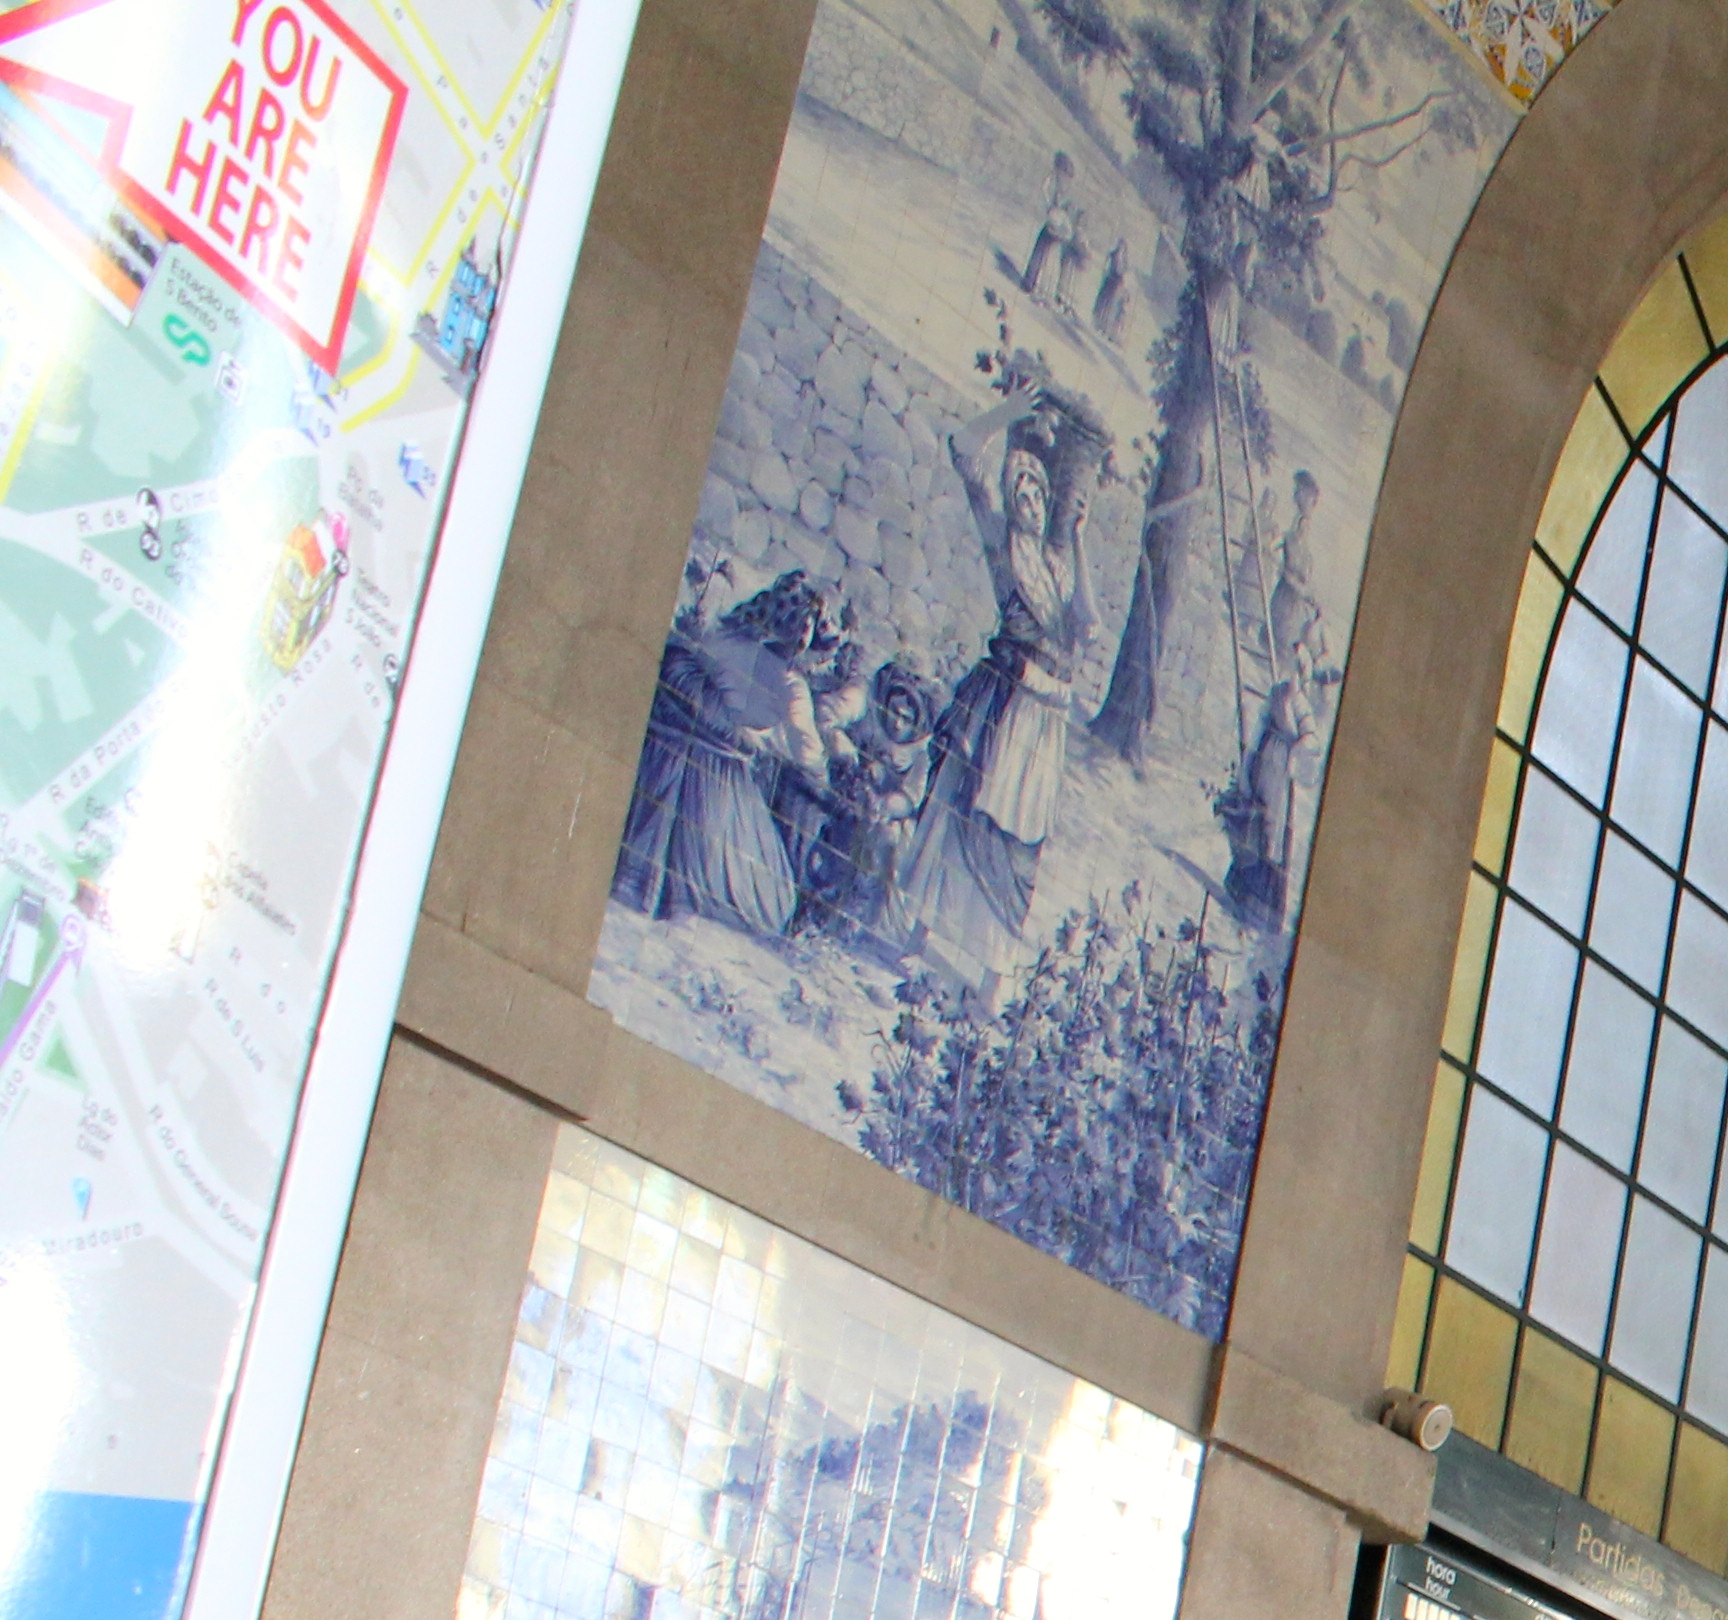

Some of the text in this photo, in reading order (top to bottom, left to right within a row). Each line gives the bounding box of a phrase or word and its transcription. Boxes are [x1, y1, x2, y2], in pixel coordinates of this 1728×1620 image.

[231, 0, 342, 122] YOU
[202, 58, 318, 206] ARE
[165, 117, 311, 302] HERE
[171, 257, 223, 311] Estação
[177, 288, 218, 332] Bento
[77, 512, 92, 533] R
[103, 509, 126, 528] de
[79, 548, 93, 571] R
[102, 566, 123, 592] do
[49, 783, 64, 804] R
[70, 764, 90, 789] da
[94, 720, 141, 767] Porta
[20, 1000, 57, 1061] Gama
[1424, 1575, 1453, 1601] hour
[1425, 1556, 1456, 1587] hora
[1577, 1521, 1667, 1599] Partidas
